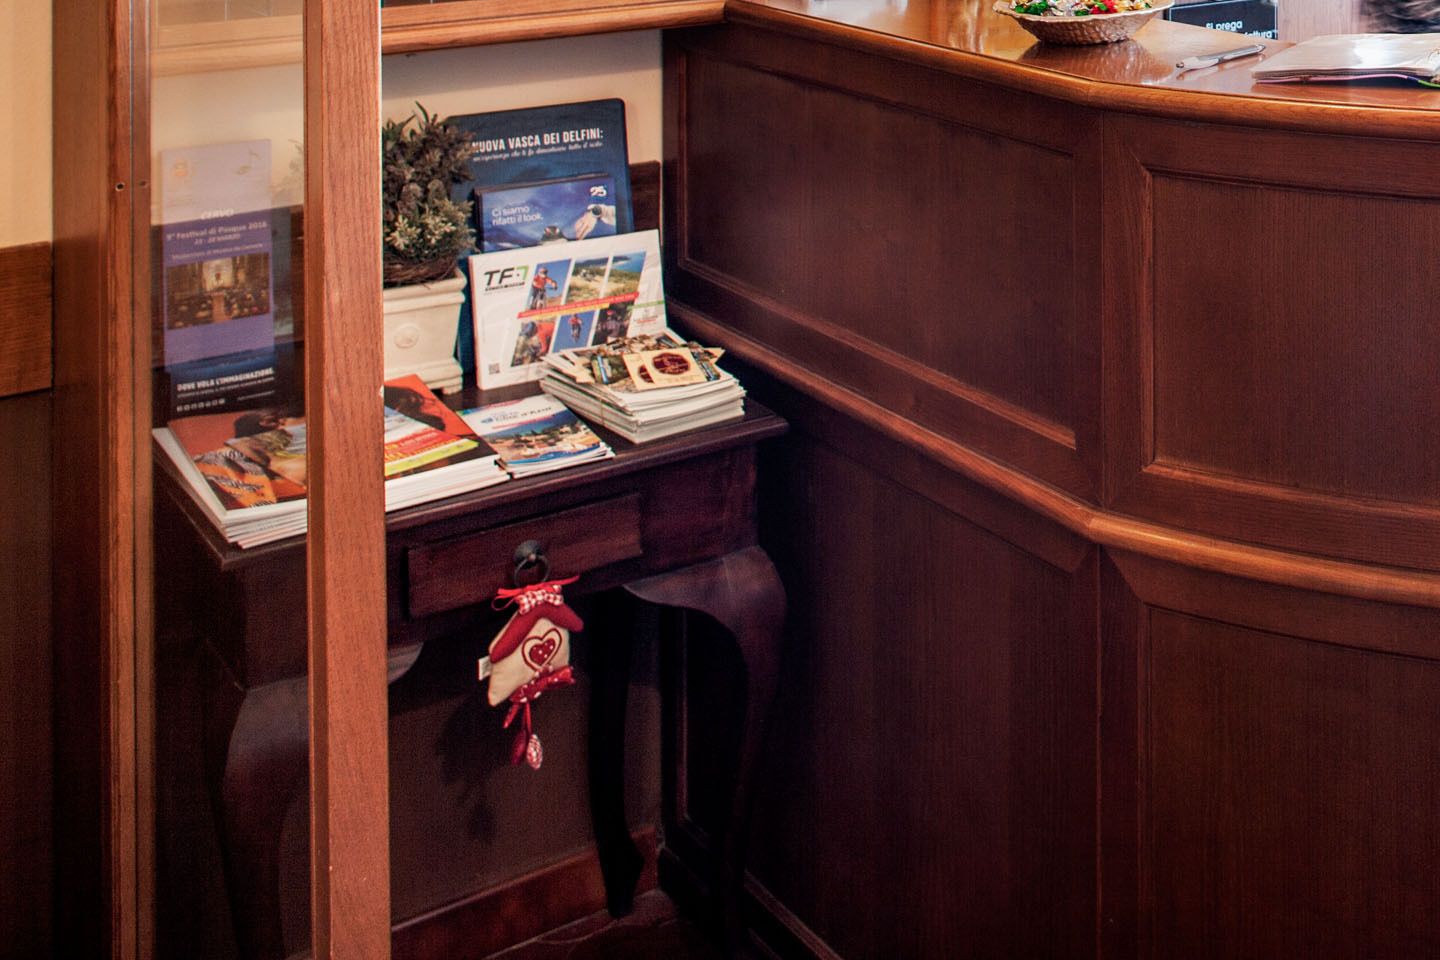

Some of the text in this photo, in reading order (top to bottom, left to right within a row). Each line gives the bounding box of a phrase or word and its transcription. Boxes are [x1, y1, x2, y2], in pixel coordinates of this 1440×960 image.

[508, 134, 540, 149] VASCA
[543, 132, 560, 145] DEI
[563, 127, 604, 143] DELFINI:
[492, 205, 530, 218] Ci siamo
[177, 228, 208, 239] Festival
